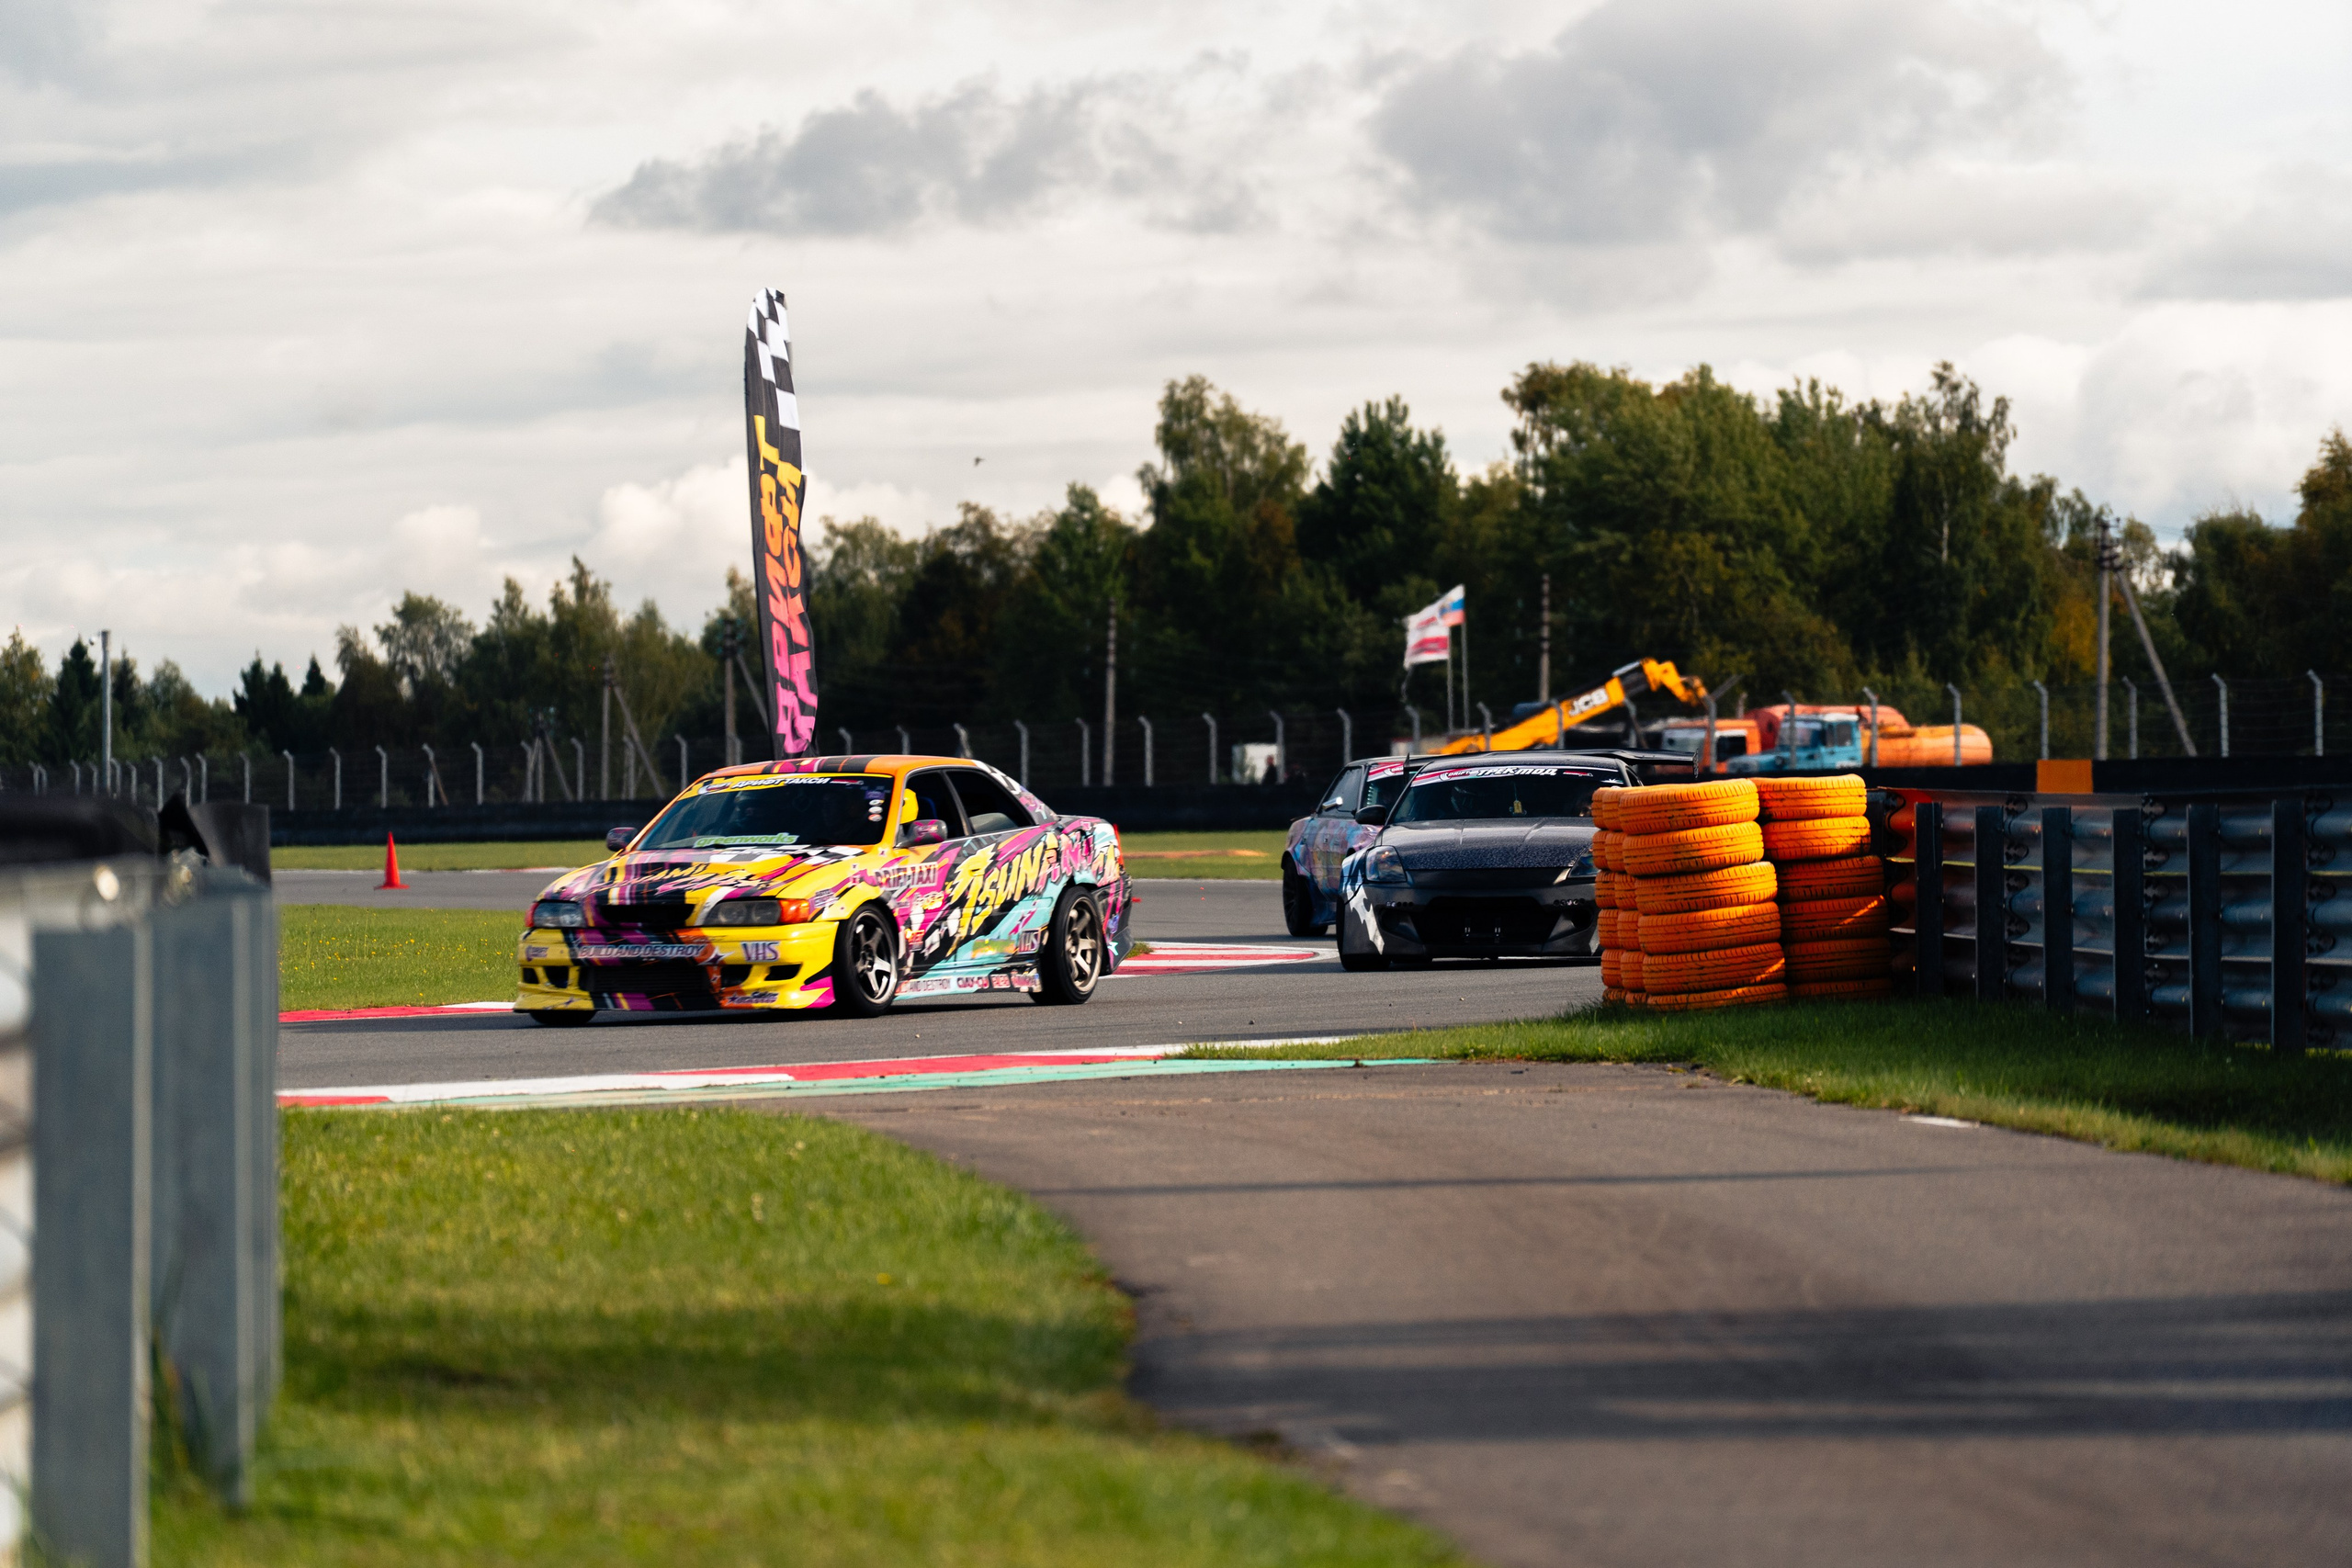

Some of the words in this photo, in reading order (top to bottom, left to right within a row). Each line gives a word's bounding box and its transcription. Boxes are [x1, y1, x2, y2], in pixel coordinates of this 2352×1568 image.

[753, 414, 797, 735] ДРИФТ
[1568, 687, 1609, 716] JCB
[695, 832, 798, 847] greenworks
[579, 944, 615, 958] BUILD
[615, 944, 641, 958] AND
[641, 943, 707, 957] DESTROY
[741, 942, 779, 962] VHS
